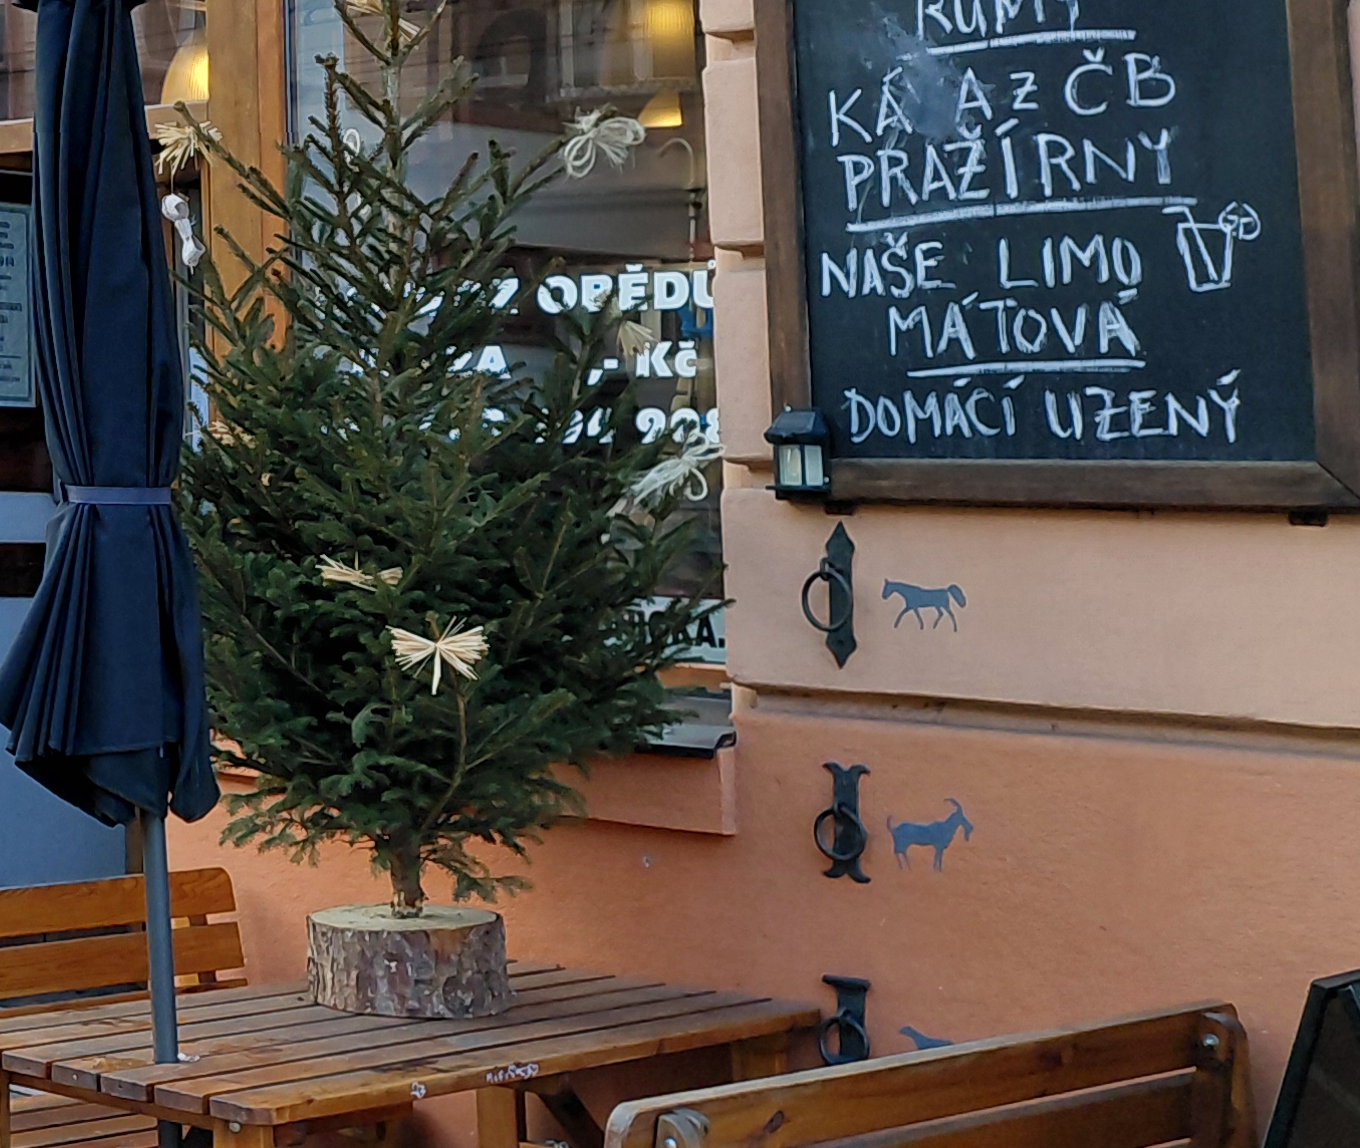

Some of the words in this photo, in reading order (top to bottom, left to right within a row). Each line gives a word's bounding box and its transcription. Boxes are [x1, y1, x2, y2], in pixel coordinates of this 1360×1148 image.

[829, 66, 994, 148] KÁA
[1065, 48, 1177, 116] ČB
[836, 118, 1178, 211] PRAŽÍRNY
[821, 231, 957, 299] NAŠE
[997, 233, 1144, 290] LIMO
[887, 288, 1141, 359] MÁTOVÁ
[843, 374, 1026, 444] DOMÁCÍ
[1044, 368, 1242, 444] UZENÝ
